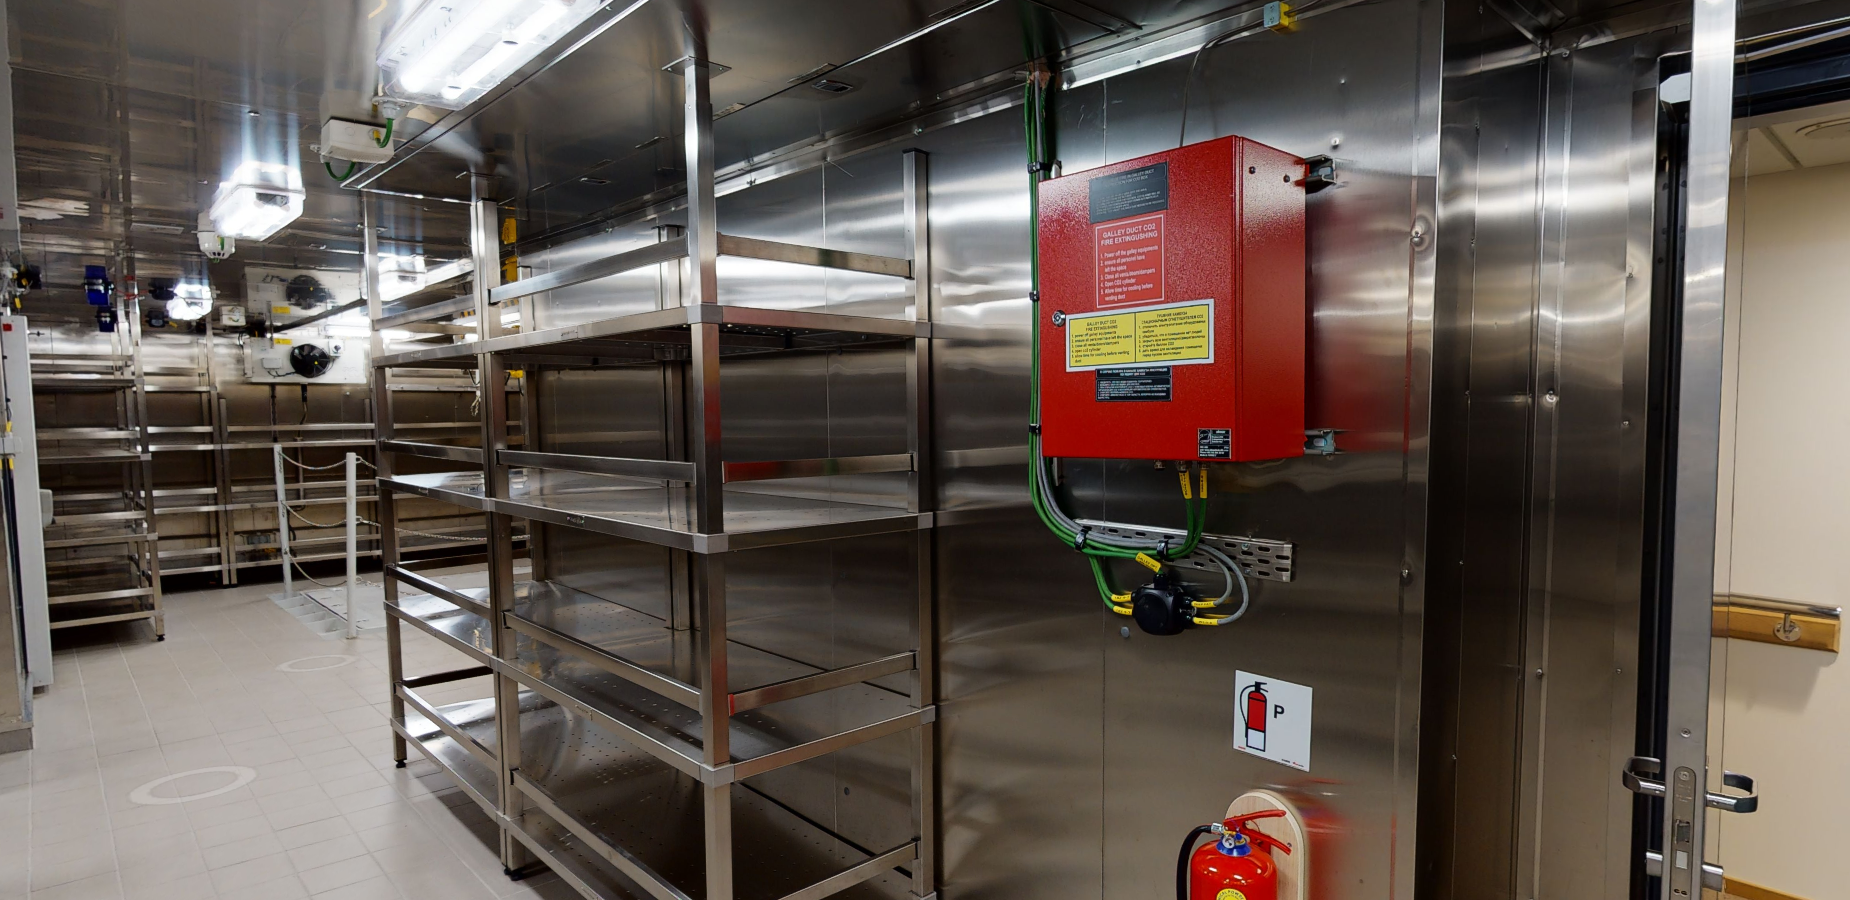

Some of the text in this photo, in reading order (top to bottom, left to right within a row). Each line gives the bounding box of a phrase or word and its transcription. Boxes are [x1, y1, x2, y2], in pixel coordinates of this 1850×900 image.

[1103, 229, 1125, 238] GALLEY
[1126, 226, 1141, 234] DUCT
[1274, 704, 1284, 718] P
